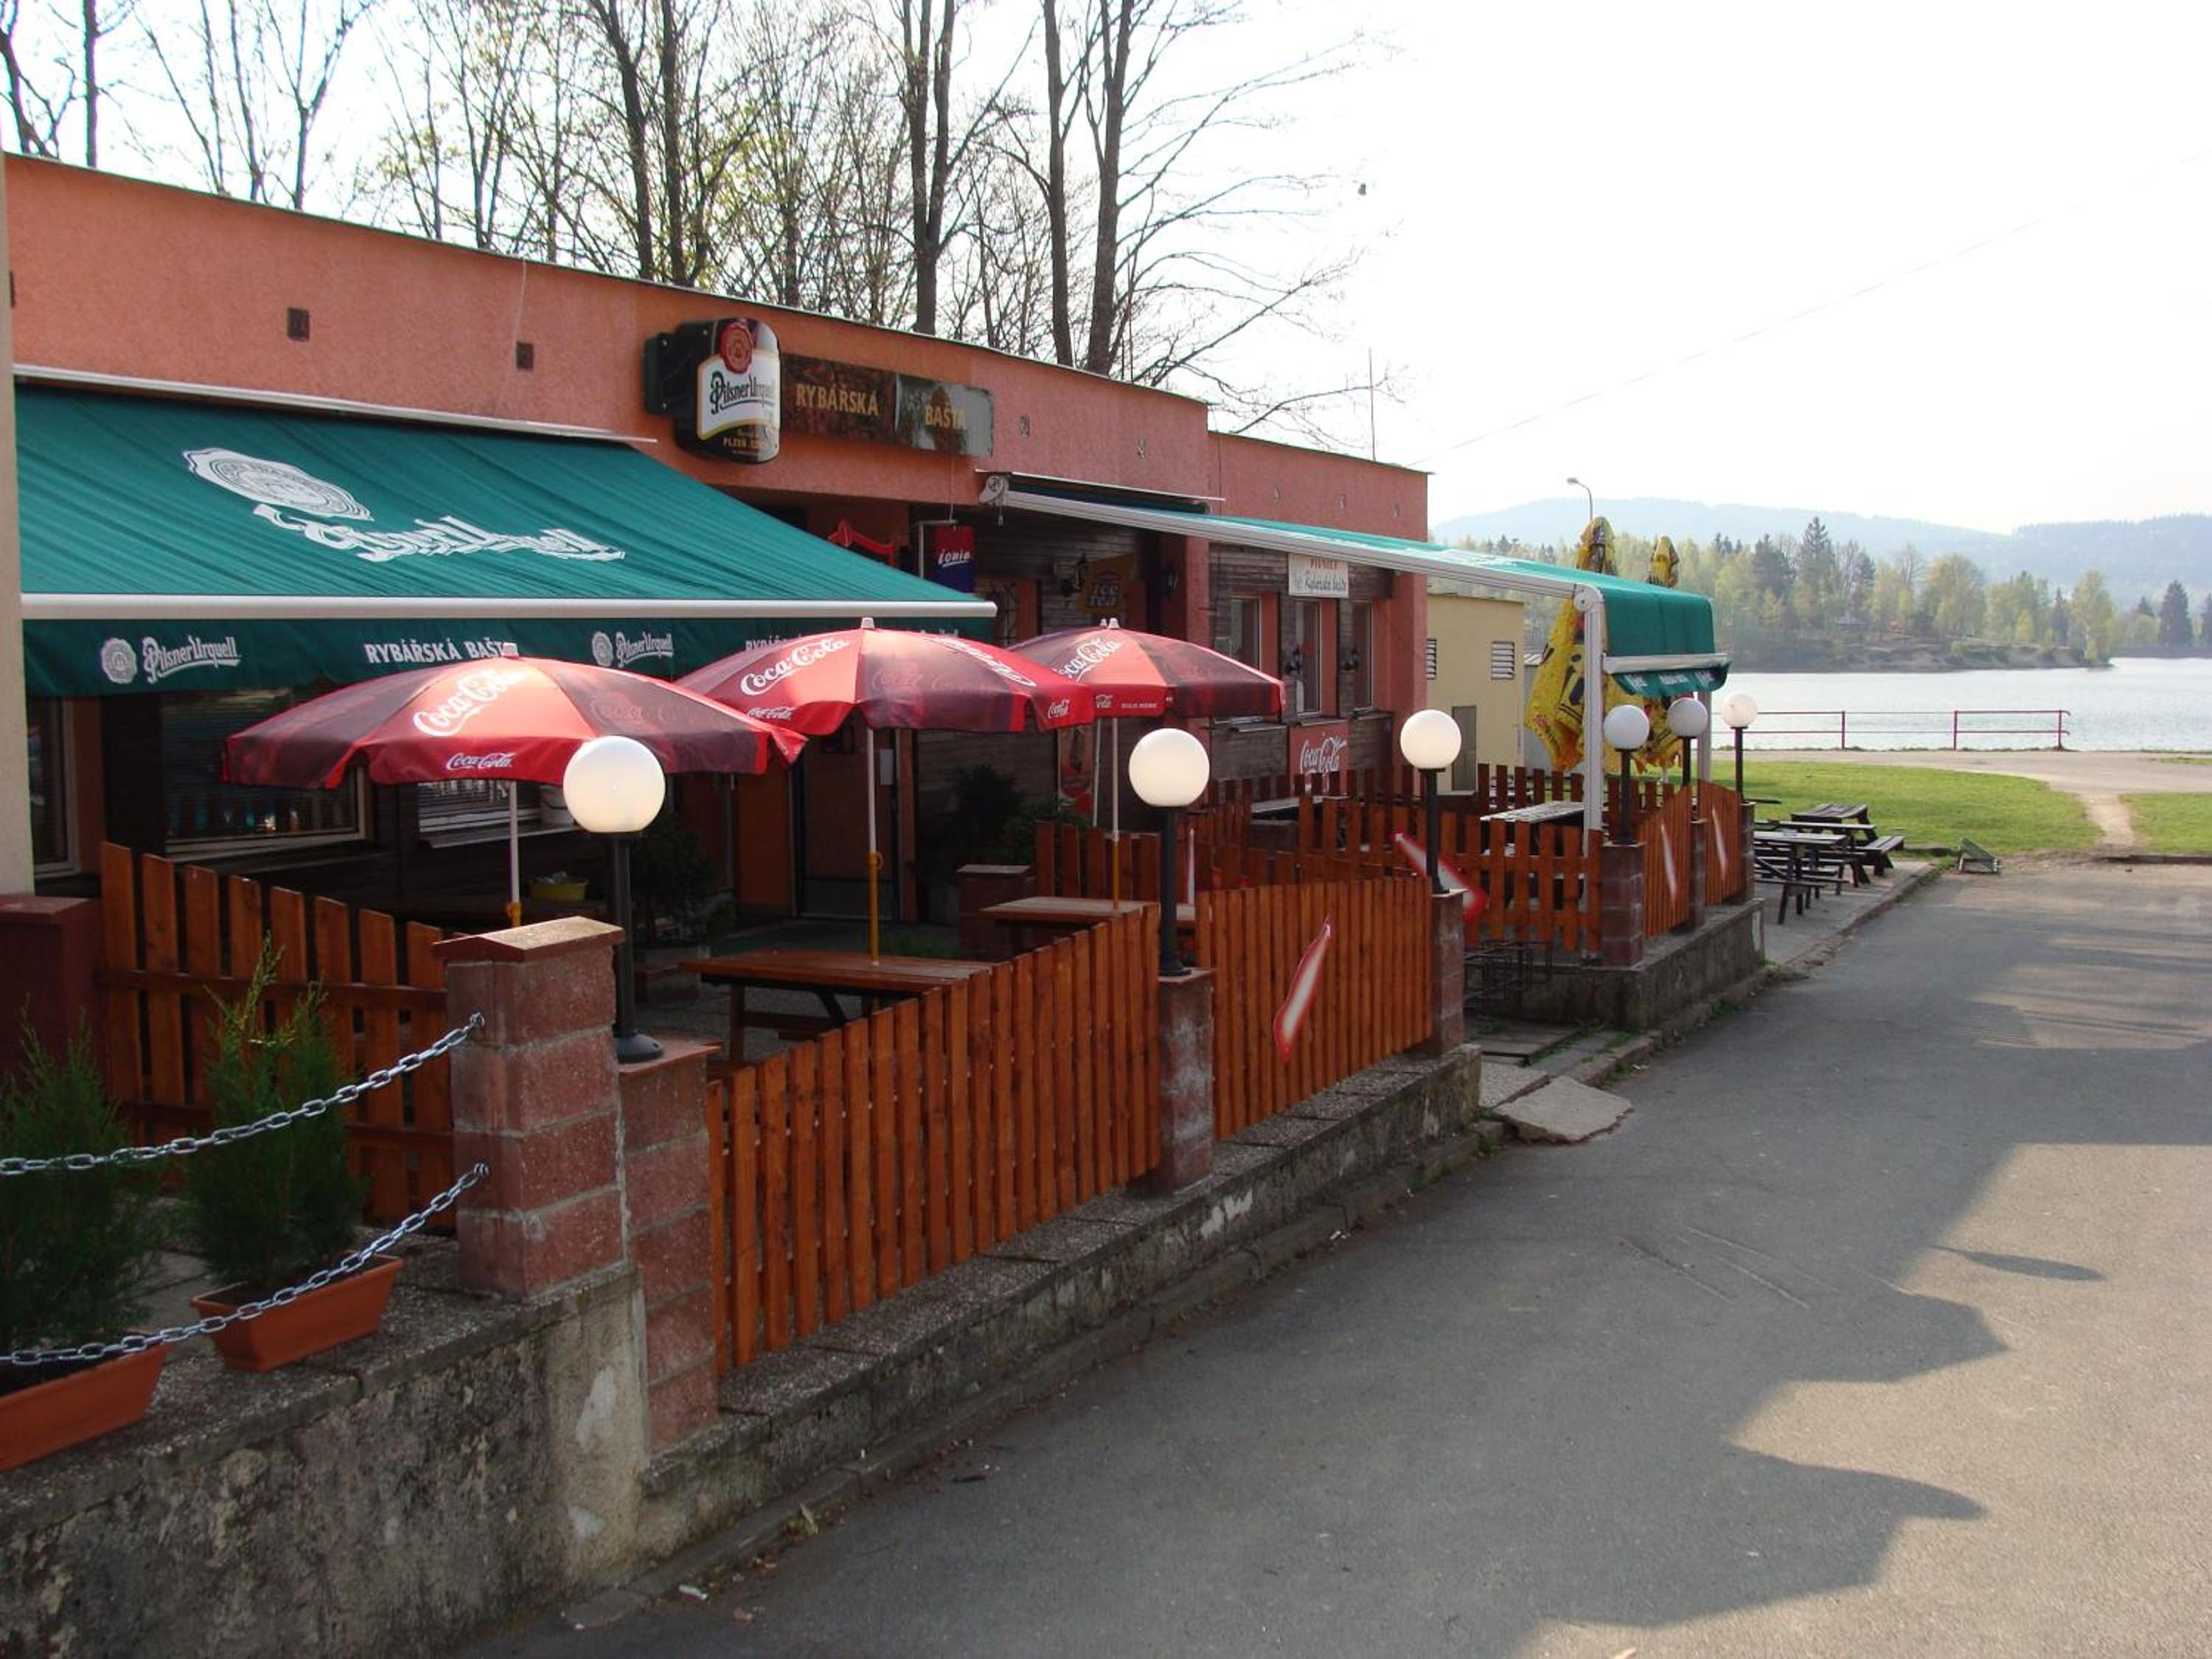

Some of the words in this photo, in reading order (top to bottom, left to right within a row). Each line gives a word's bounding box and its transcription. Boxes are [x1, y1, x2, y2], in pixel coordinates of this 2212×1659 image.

[709, 371, 750, 415] Pilsner
[796, 382, 879, 416] RYBÁŘSKÁ
[925, 400, 967, 430] BAŠTA
[142, 637, 192, 684] Pilsner
[189, 635, 238, 669] Urquell
[364, 638, 462, 664] RYBÁŘSKÁ
[464, 637, 504, 658] BAŠT
[616, 632, 646, 668] Pilsner
[642, 631, 672, 659] Urquell
[740, 637, 849, 695] Coca-Cola
[413, 669, 532, 737] Coca-Cola
[446, 752, 516, 771] Coca-Cola
